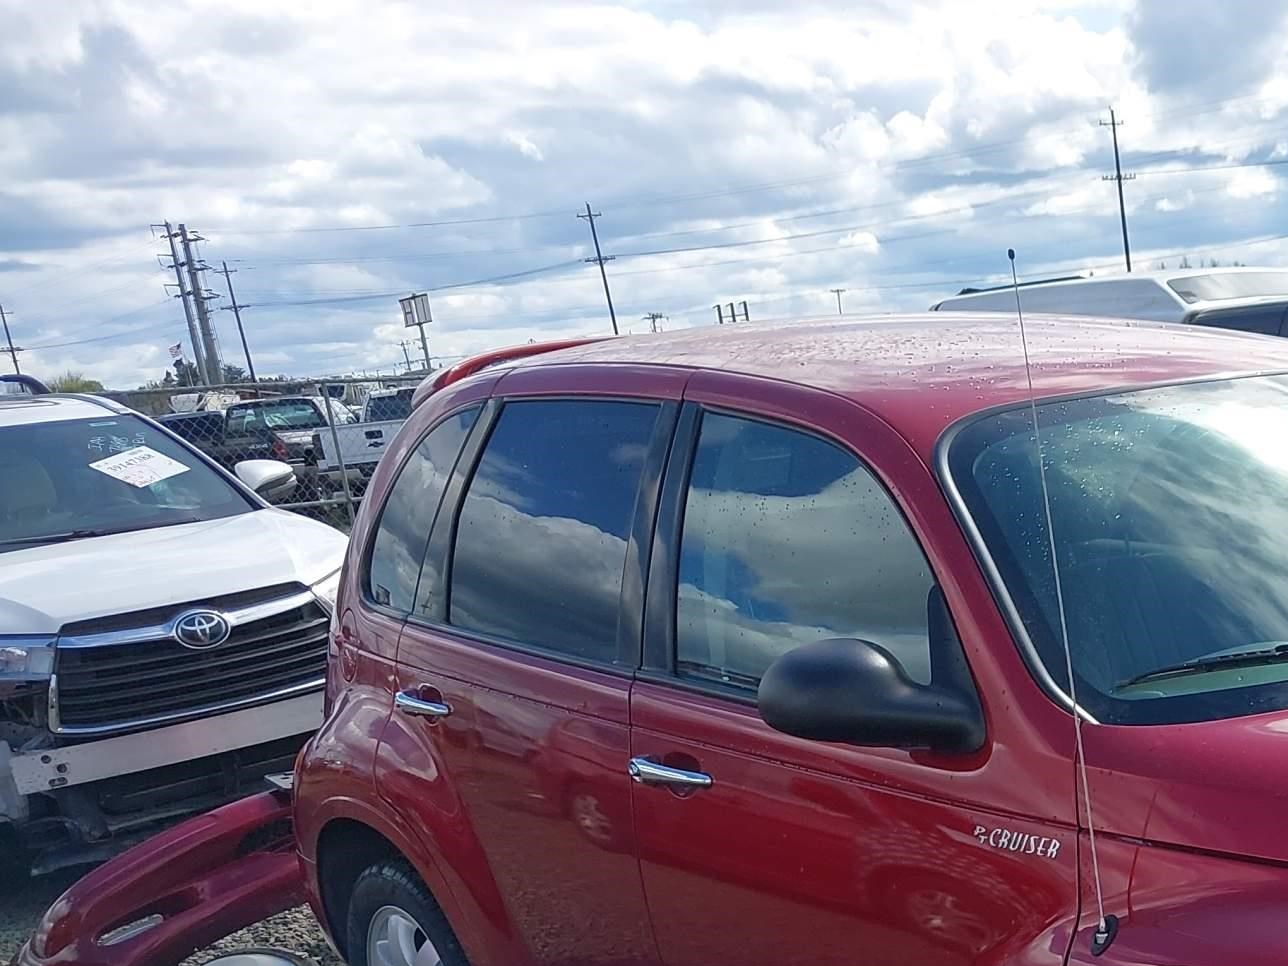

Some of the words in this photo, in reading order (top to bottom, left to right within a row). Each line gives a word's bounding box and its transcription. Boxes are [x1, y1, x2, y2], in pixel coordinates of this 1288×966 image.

[402, 299, 415, 325] H
[973, 825, 988, 844] PT
[989, 828, 1061, 859] CRUISER
